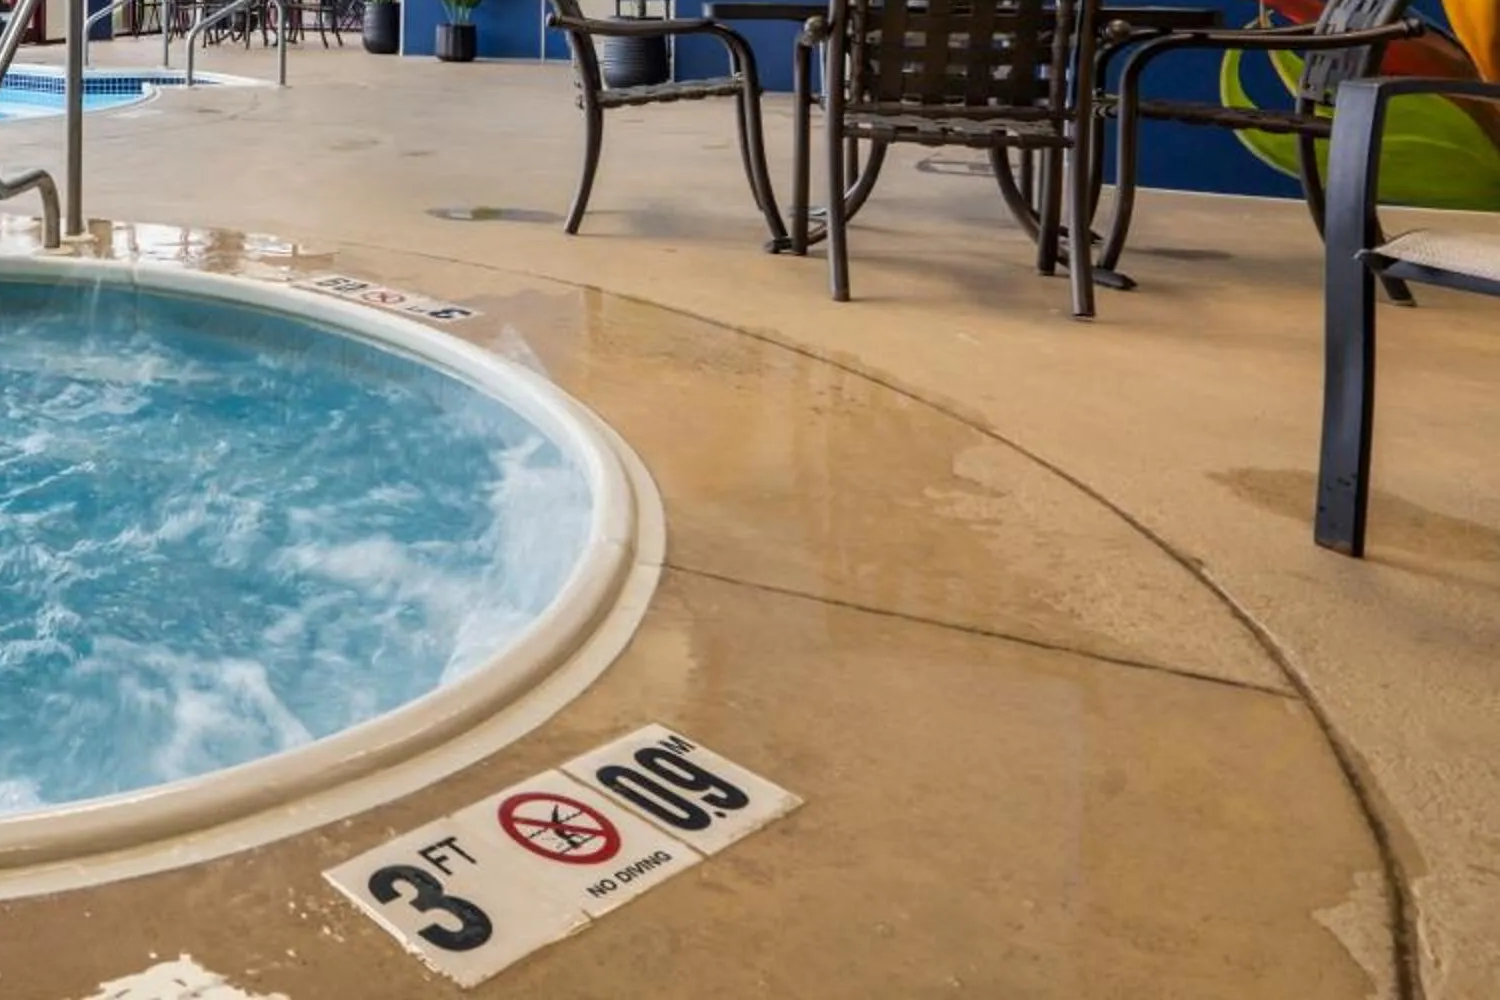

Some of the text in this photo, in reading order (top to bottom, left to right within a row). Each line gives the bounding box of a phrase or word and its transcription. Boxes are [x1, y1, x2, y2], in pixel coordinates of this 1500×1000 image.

[367, 836, 493, 952] 3 FT
[586, 850, 673, 898] NO DIVING
